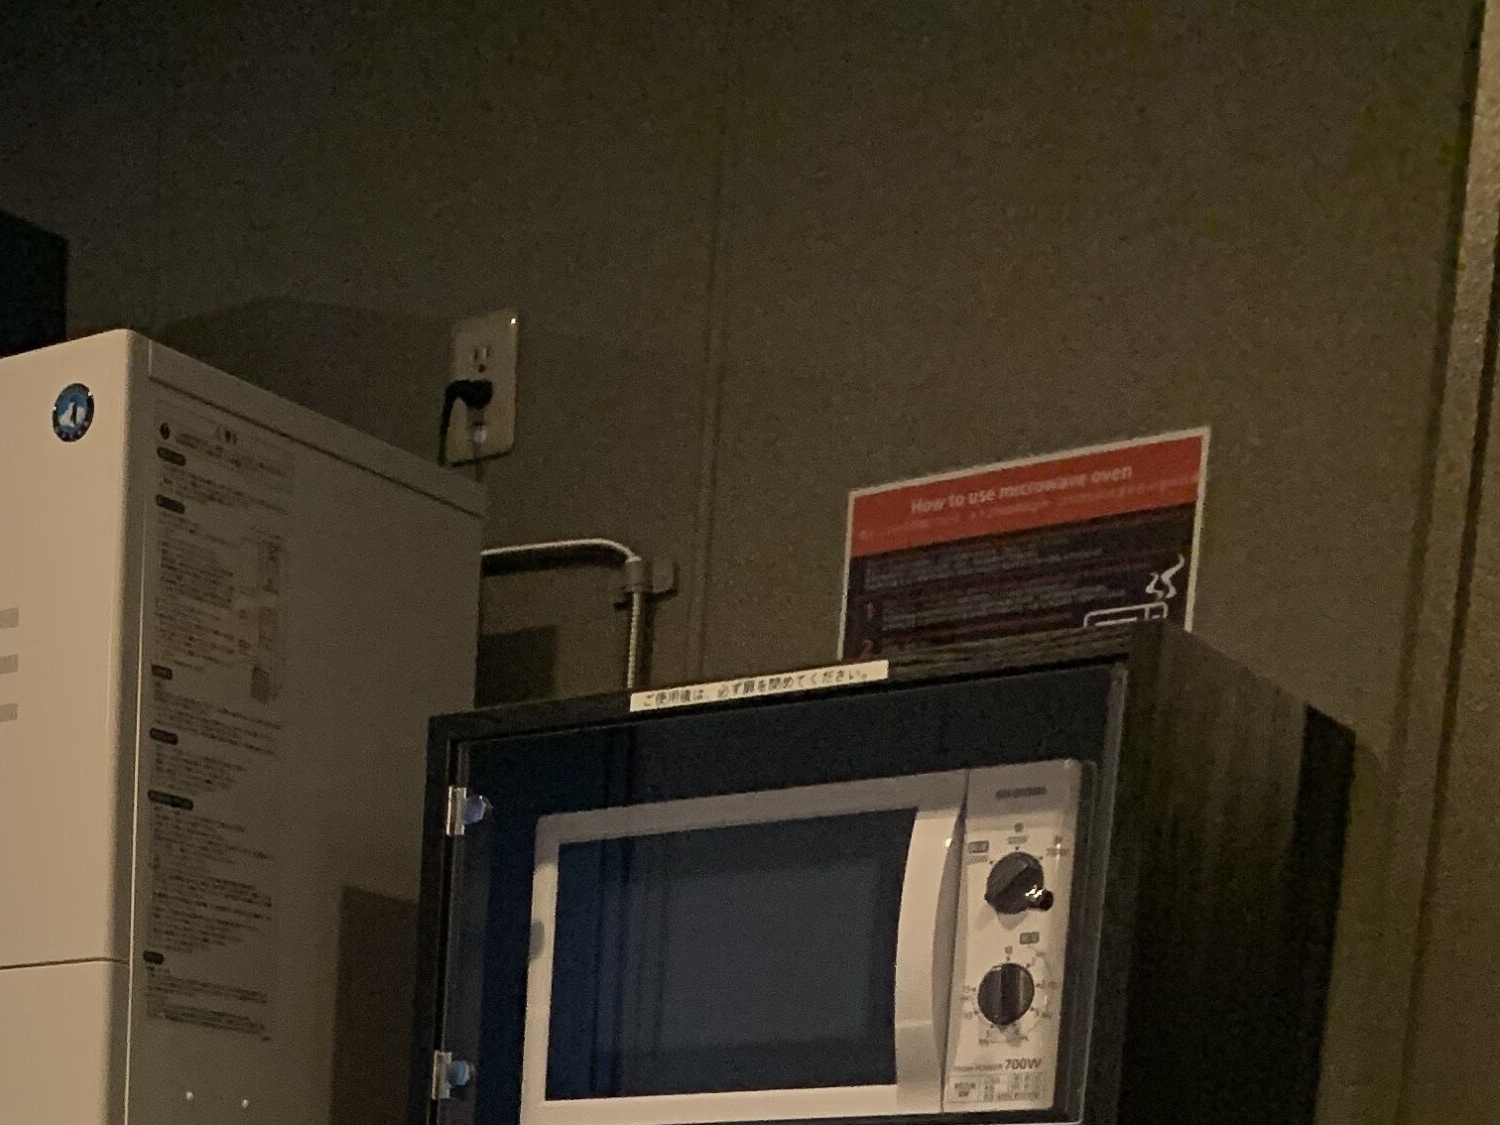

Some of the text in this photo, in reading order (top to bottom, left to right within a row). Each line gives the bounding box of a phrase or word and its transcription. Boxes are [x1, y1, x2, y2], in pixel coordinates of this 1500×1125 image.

[911, 498, 945, 514] How
[948, 492, 965, 508] to
[968, 488, 996, 505] use
[999, 473, 1087, 498] microwave
[1091, 465, 1133, 483] oven
[1004, 1058, 1042, 1071] 700W
